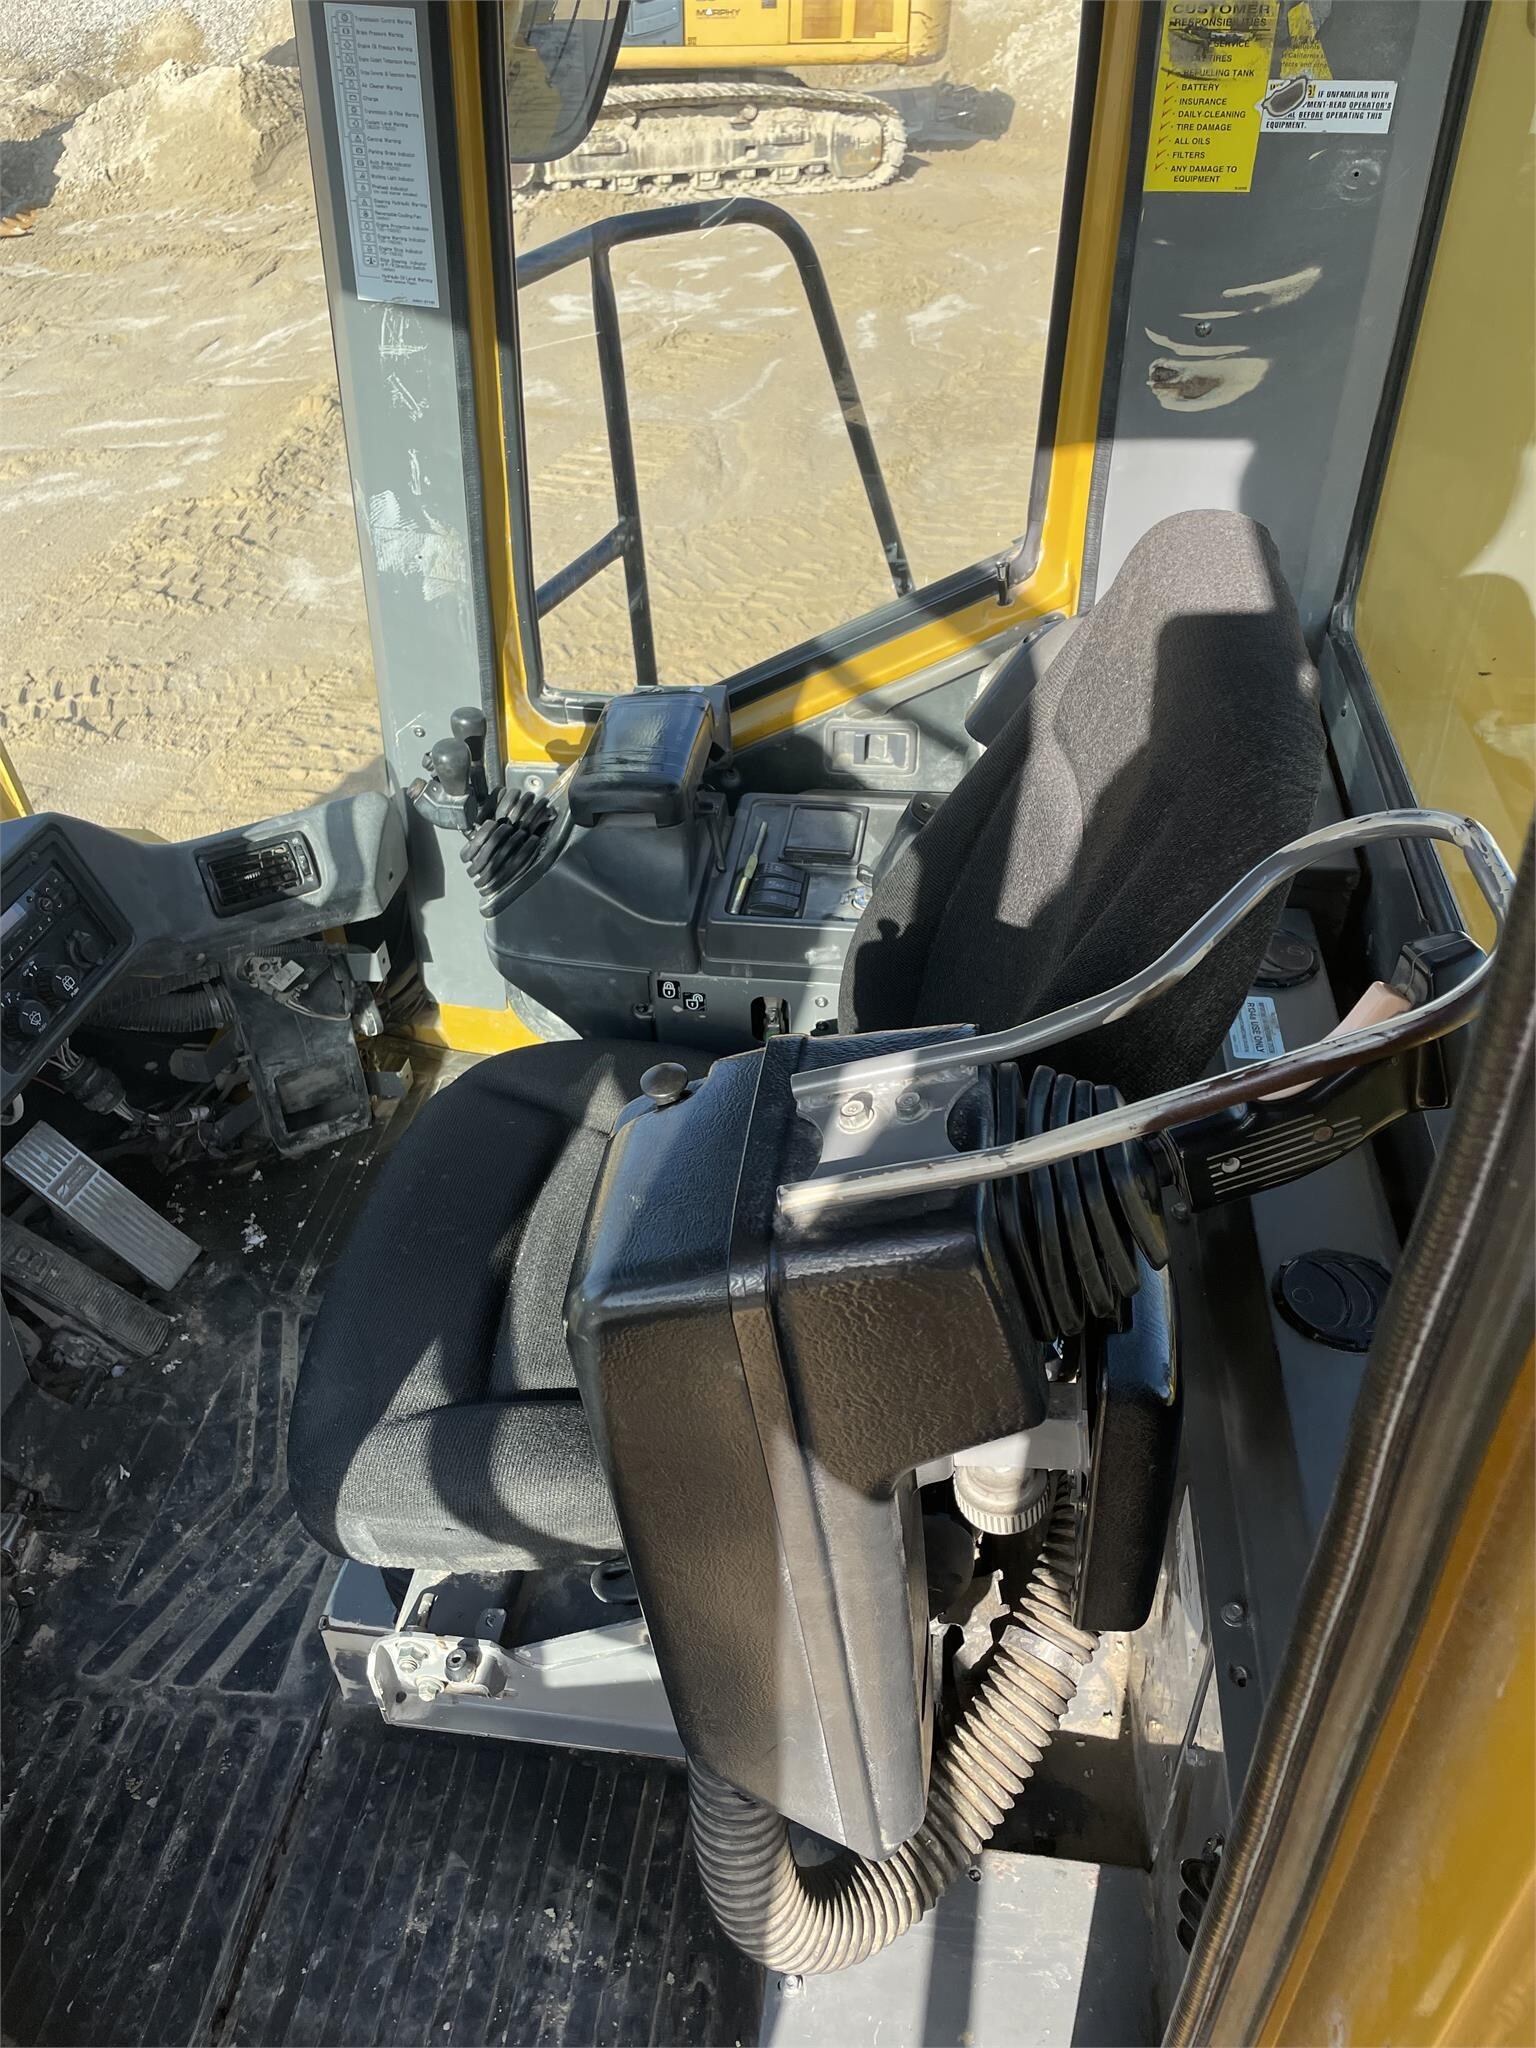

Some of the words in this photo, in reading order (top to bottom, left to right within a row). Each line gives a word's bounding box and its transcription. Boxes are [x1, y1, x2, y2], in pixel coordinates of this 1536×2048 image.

[1173, 4, 1270, 14] CUSTOMER
[1233, 69, 1255, 77] TANK
[1178, 110, 1202, 118] DAILY
[1298, 111, 1323, 119] BEFORE
[1176, 123, 1195, 131] TIRE
[1196, 123, 1232, 131] DAMAGE
[1266, 121, 1307, 129] EQUIPMENT.
[1174, 137, 1189, 145] ALL
[1170, 165, 1187, 173] ANY
[1251, 1021, 1261, 1035] USE
[1254, 1035, 1265, 1053] ONLY
